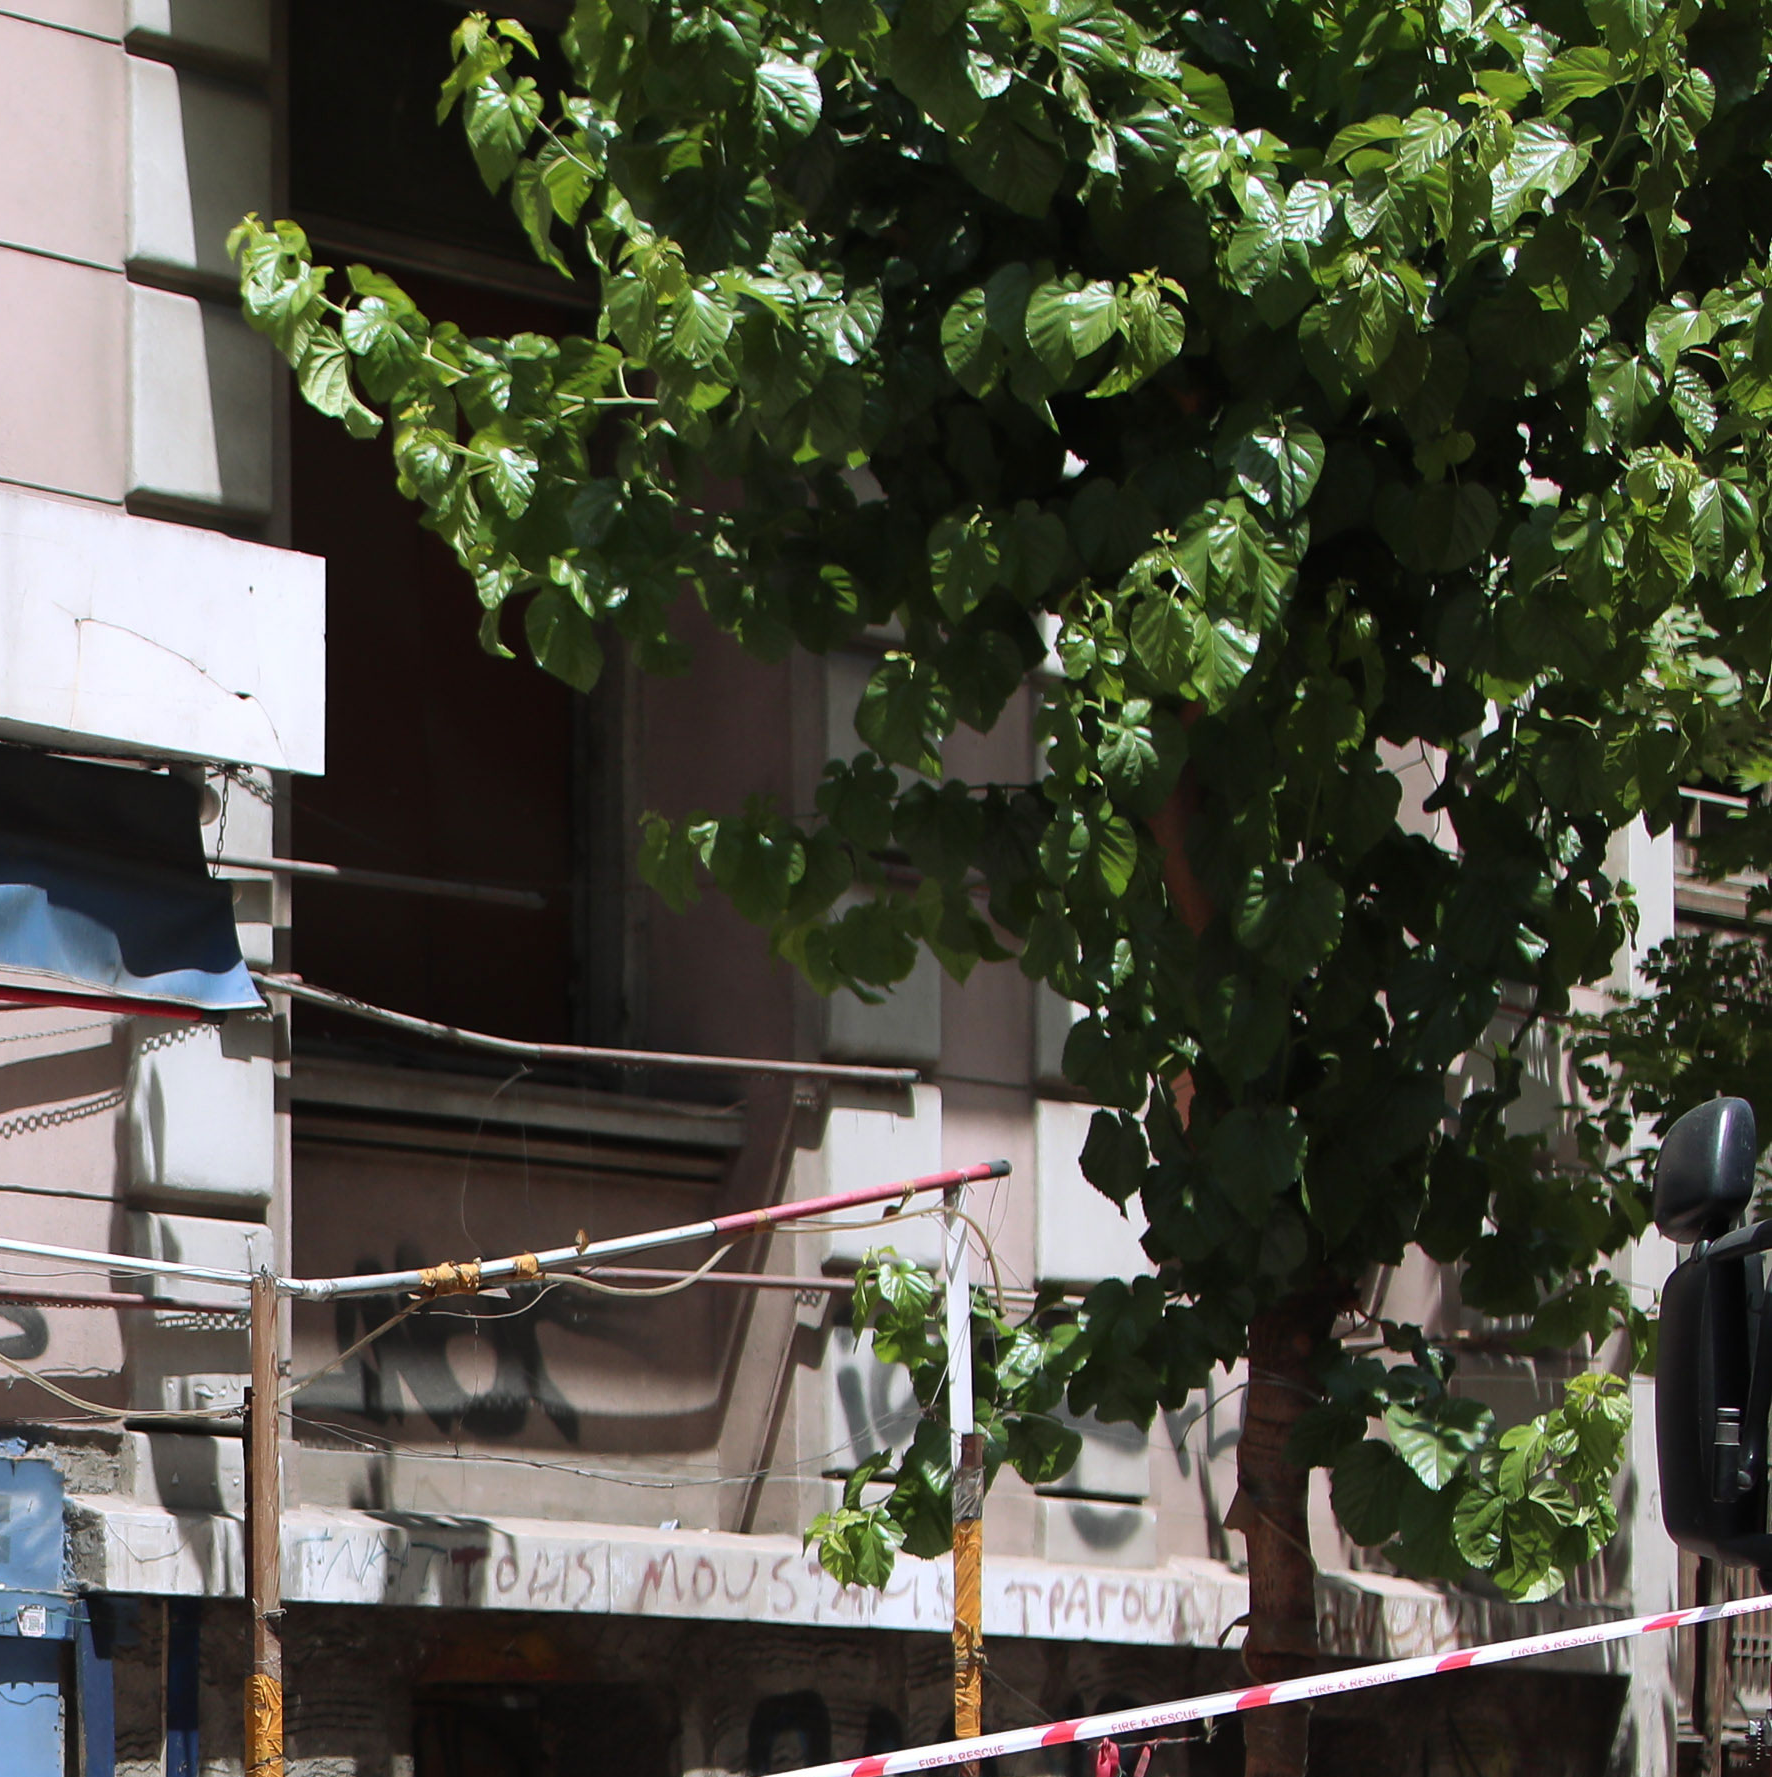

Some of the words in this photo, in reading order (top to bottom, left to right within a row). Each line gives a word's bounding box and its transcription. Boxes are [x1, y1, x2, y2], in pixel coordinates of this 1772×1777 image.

[1308, 1682, 1336, 1696] FIRE
[1110, 1720, 1137, 1734] FIRE
[1151, 1708, 1199, 1726] RESCUE
